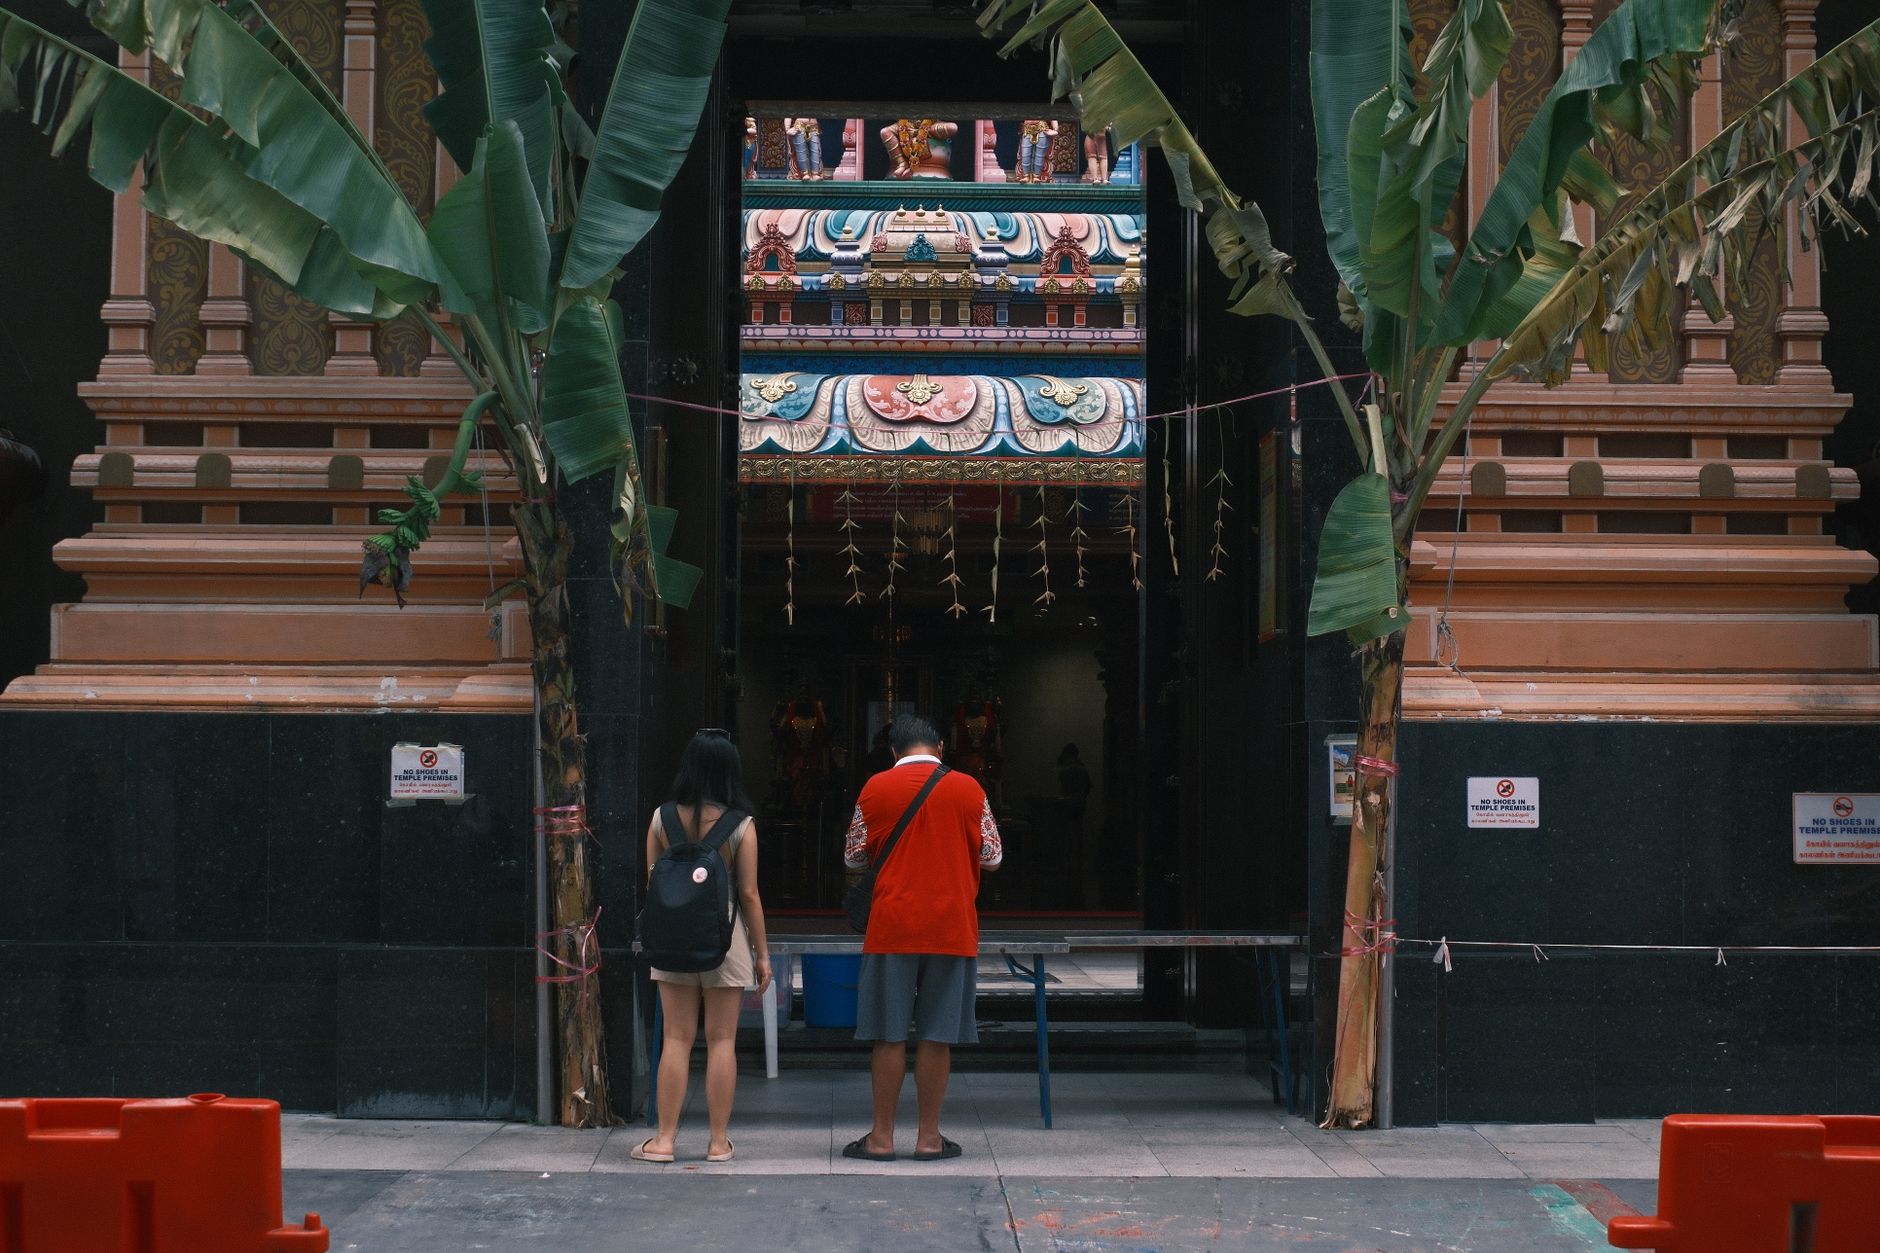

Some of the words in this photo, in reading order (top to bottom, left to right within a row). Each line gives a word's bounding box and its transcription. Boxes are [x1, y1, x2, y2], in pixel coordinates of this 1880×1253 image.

[1812, 818, 1827, 826] NO
[1829, 818, 1862, 826] SHOES
[1865, 818, 1875, 826] IN
[1799, 827, 1837, 835] TEMPLE
